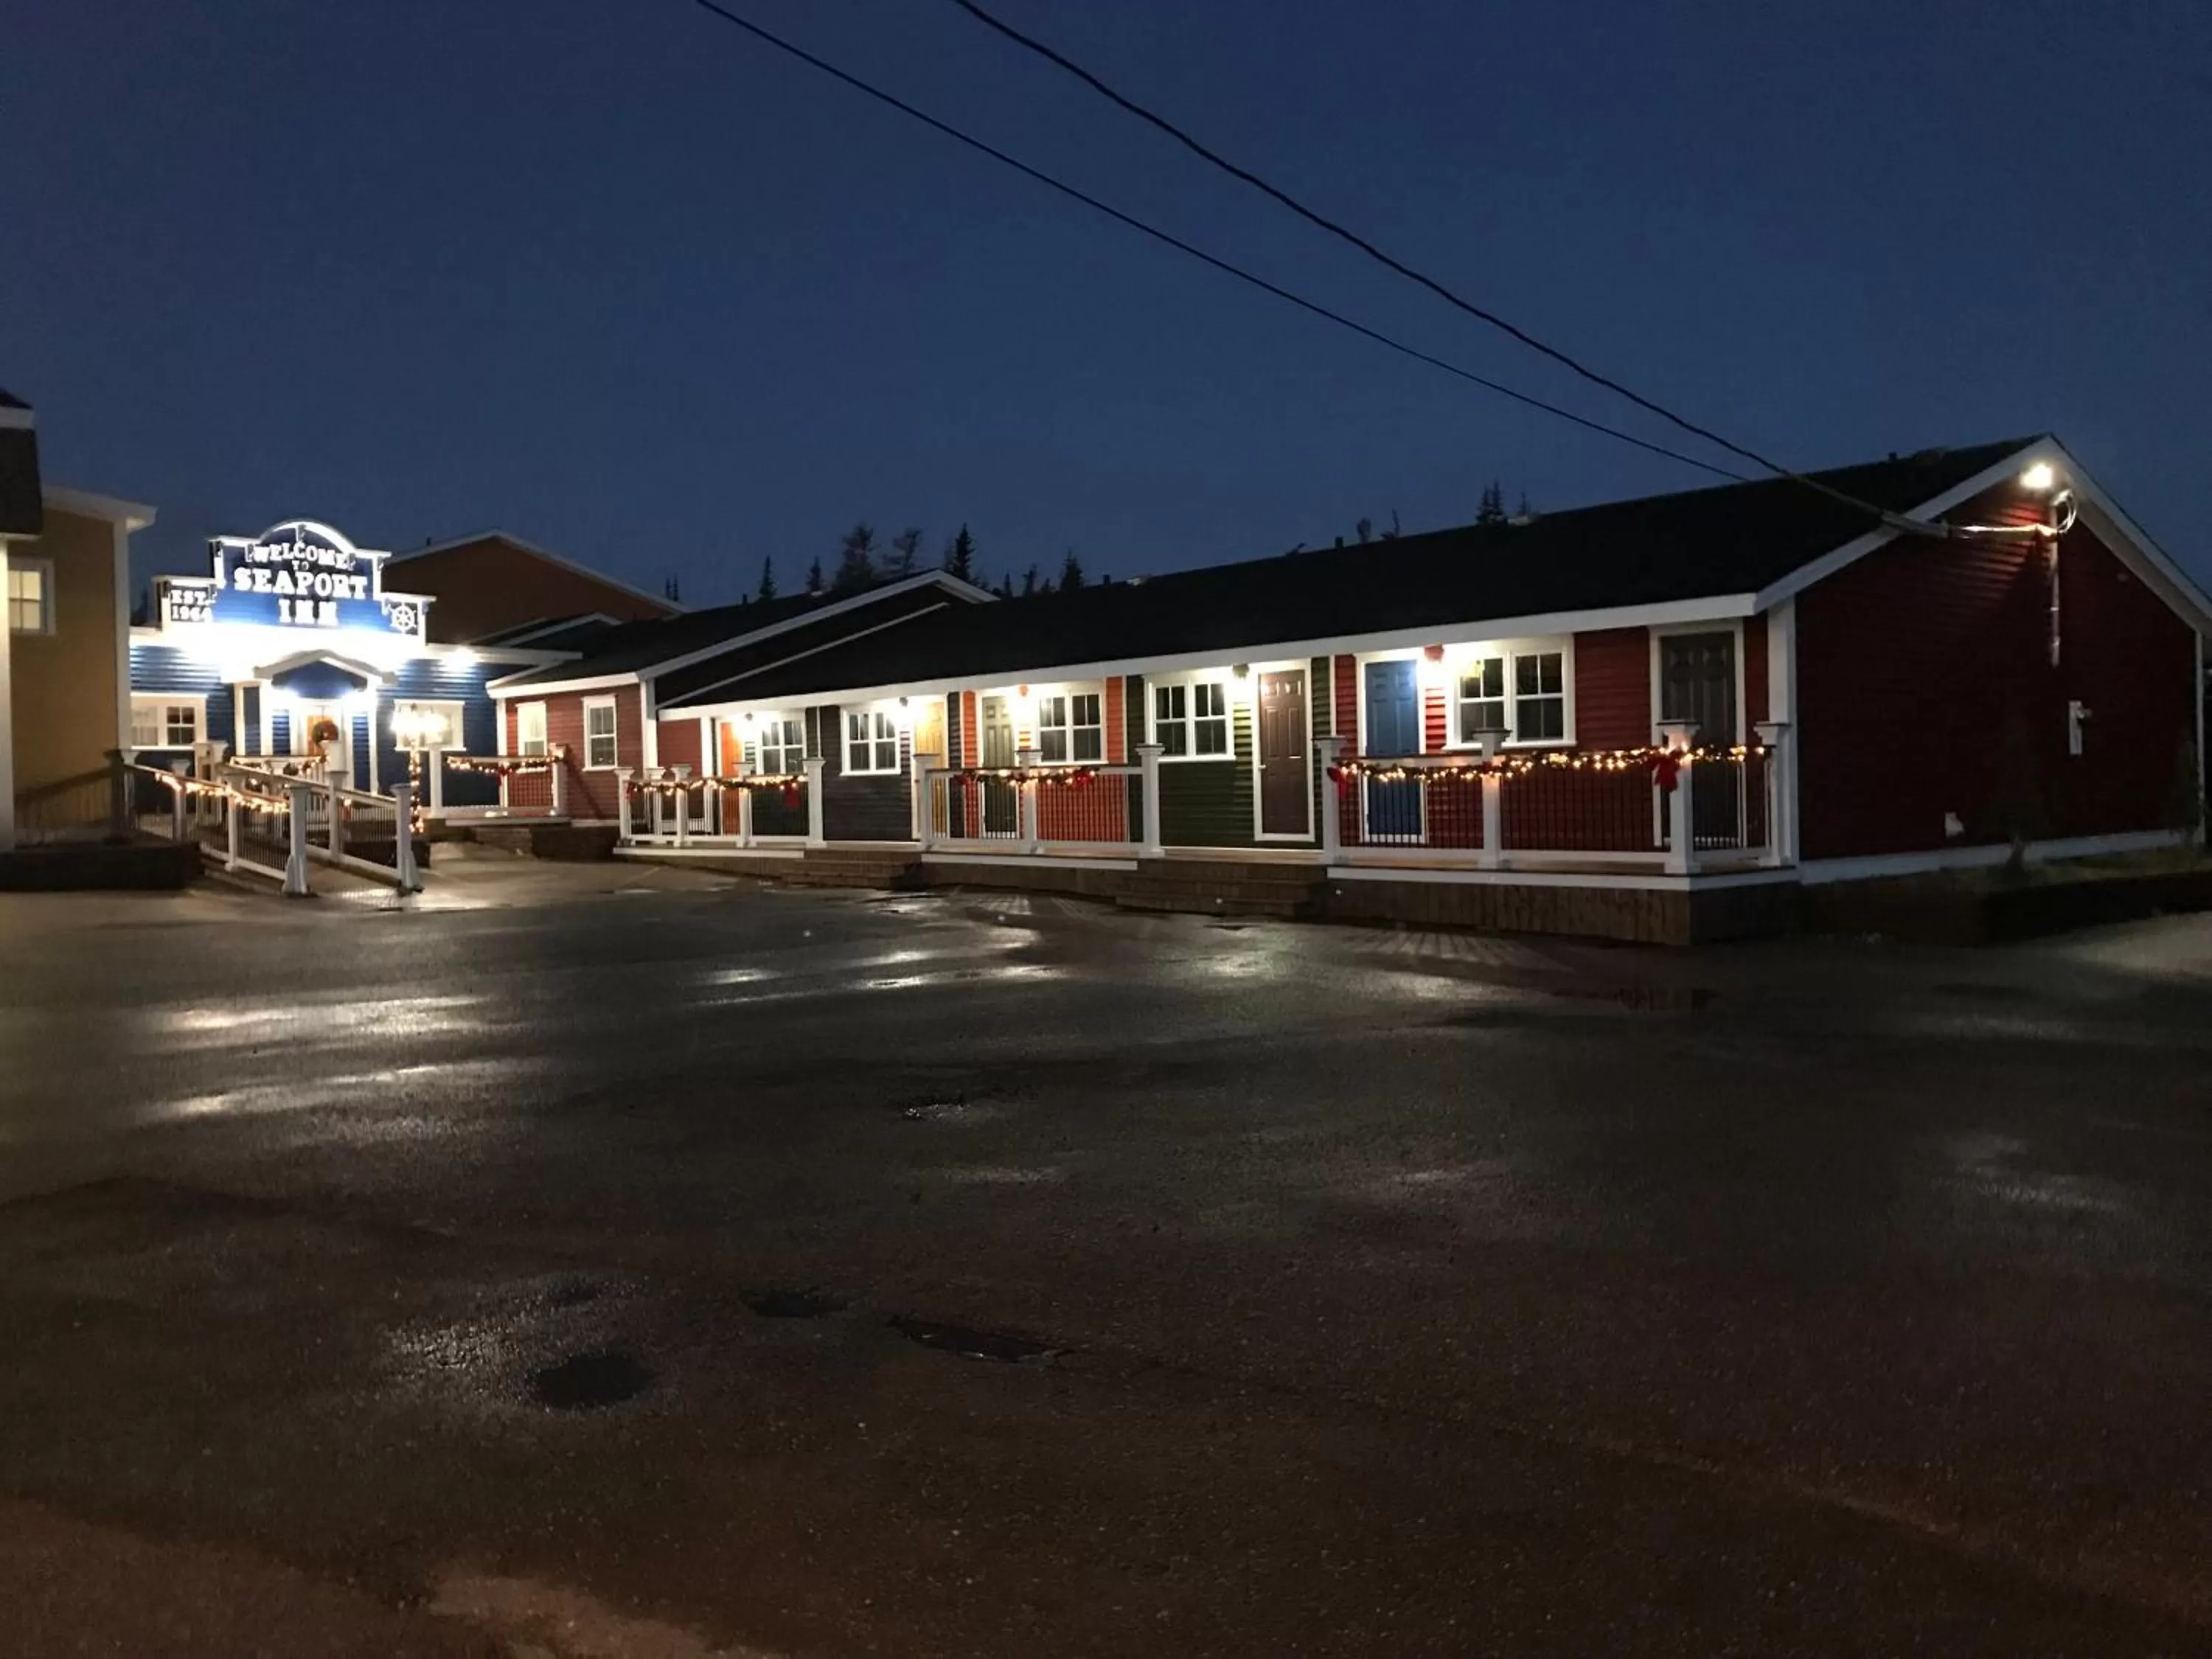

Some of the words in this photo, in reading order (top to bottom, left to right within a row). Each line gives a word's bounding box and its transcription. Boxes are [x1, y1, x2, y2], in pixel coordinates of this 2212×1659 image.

[254, 542, 349, 568] WELCOME
[292, 560, 310, 571] TO
[234, 566, 367, 599] SEAPORT
[279, 598, 338, 626] INN
